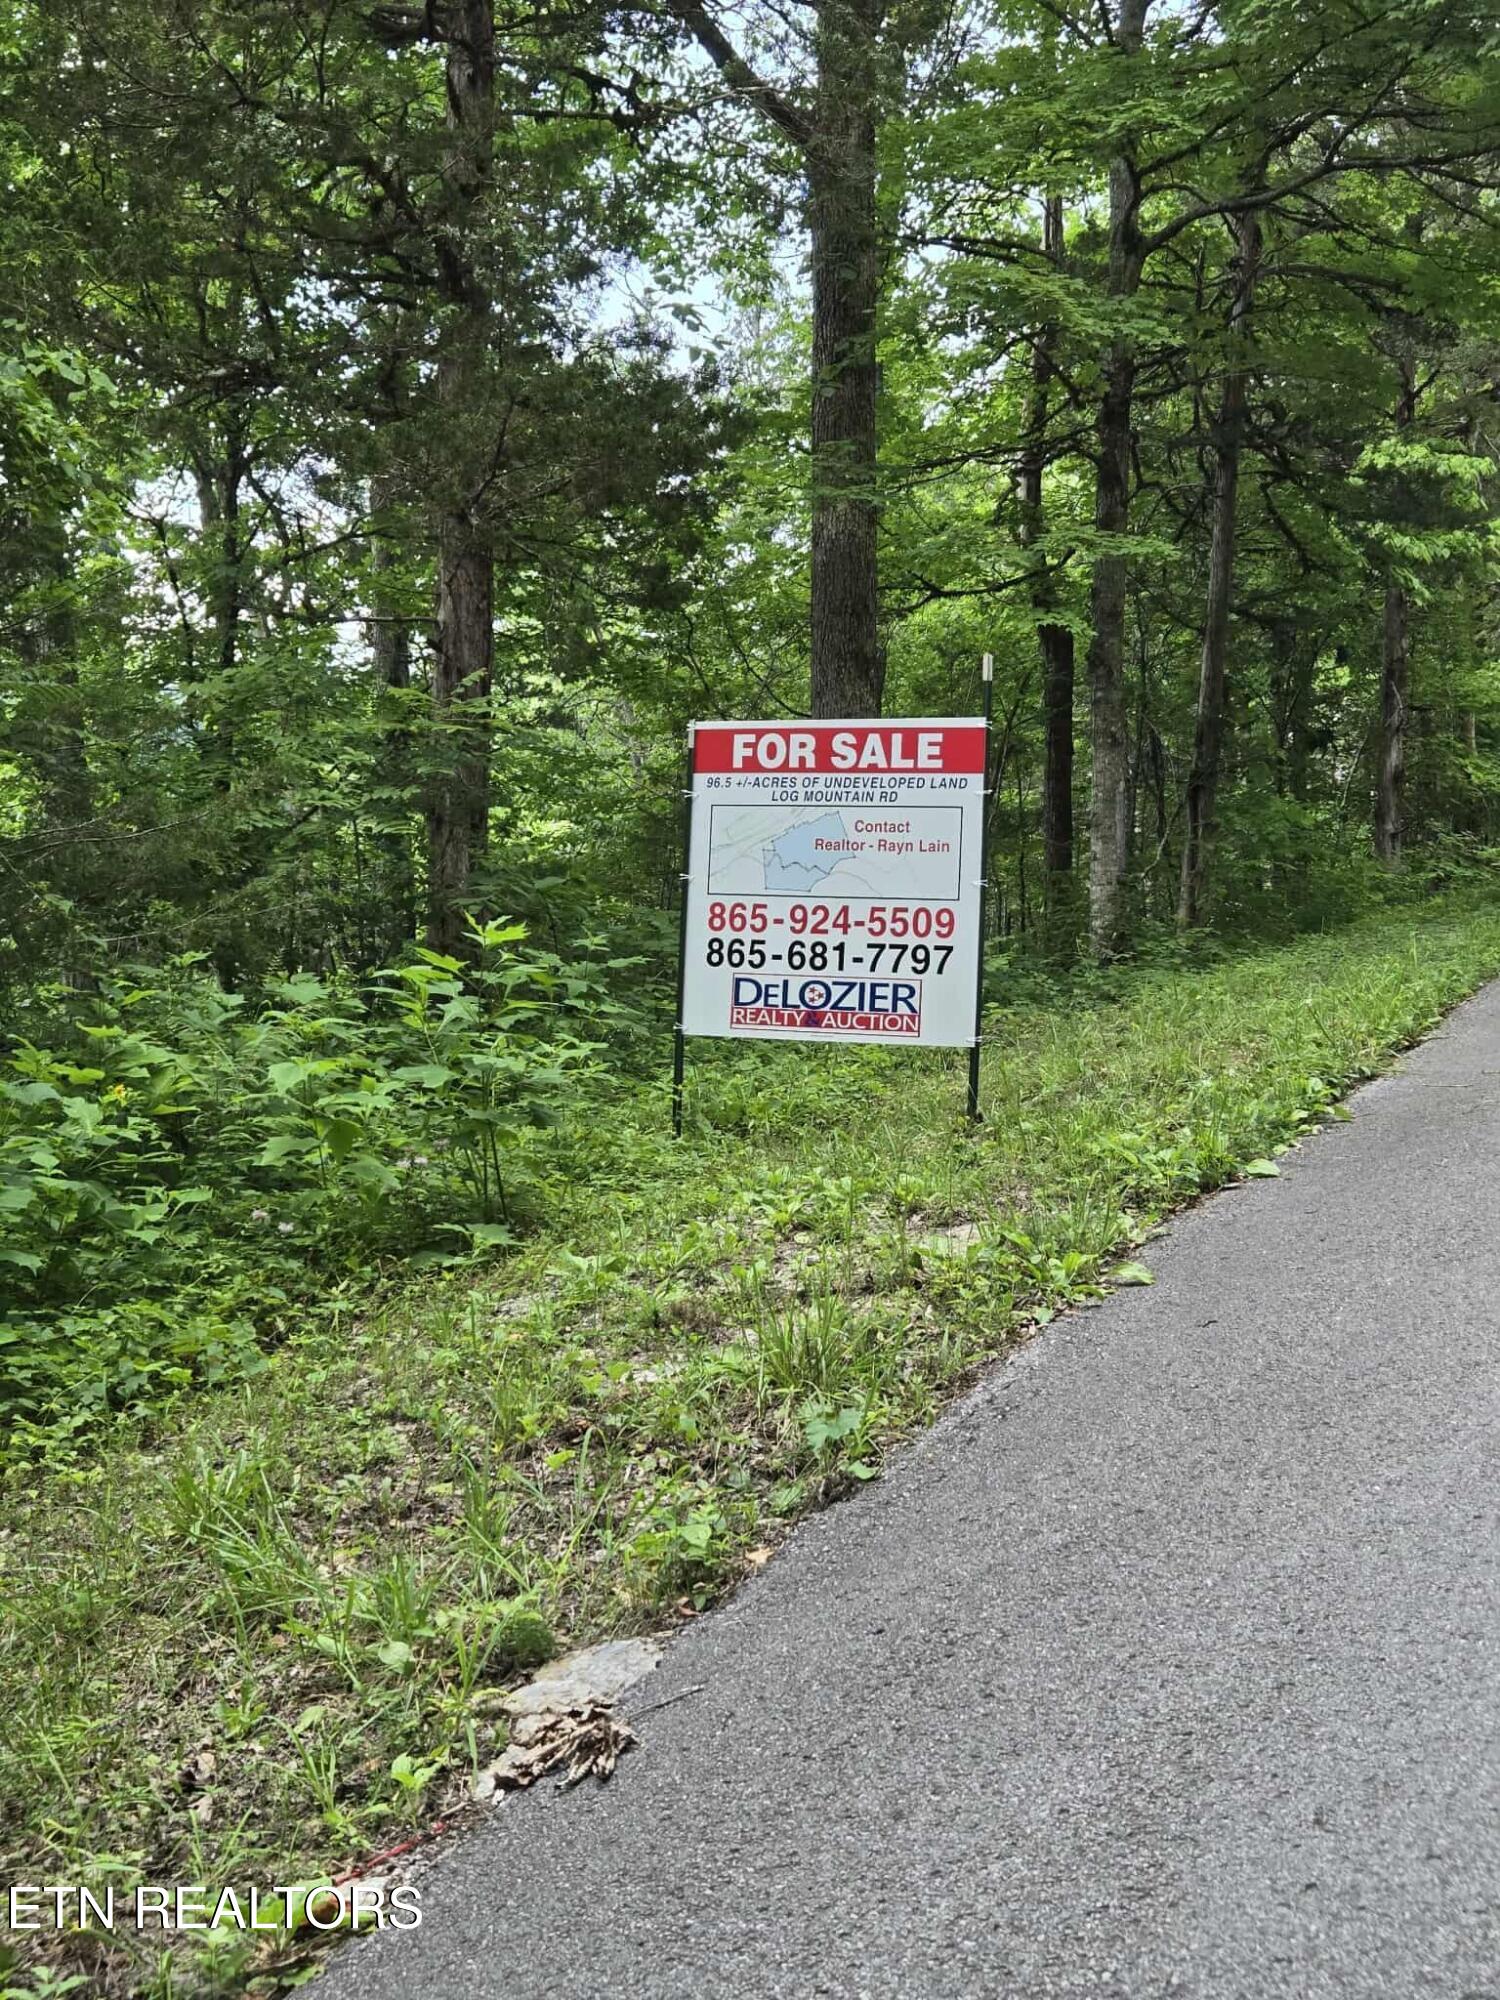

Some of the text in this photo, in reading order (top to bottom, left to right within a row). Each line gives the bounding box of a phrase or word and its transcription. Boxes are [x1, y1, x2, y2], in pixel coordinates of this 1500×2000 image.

[732, 732, 944, 769] FOR SALE
[706, 777, 732, 788] 96.5
[801, 777, 820, 788] OF
[824, 777, 926, 789] UNDEVELOPED
[930, 777, 968, 789] LAND
[771, 791, 898, 803] LOG MOUNTAIN RD
[854, 820, 910, 833] Contact
[814, 839, 866, 852] Realtor
[877, 840, 914, 855] Rayn
[919, 841, 950, 853] Lain
[707, 902, 956, 939] 865-924-5509
[706, 937, 954, 975] 865-681-7797
[732, 1008, 805, 1026] REALTY
[821, 1012, 919, 1031] AUCTION
